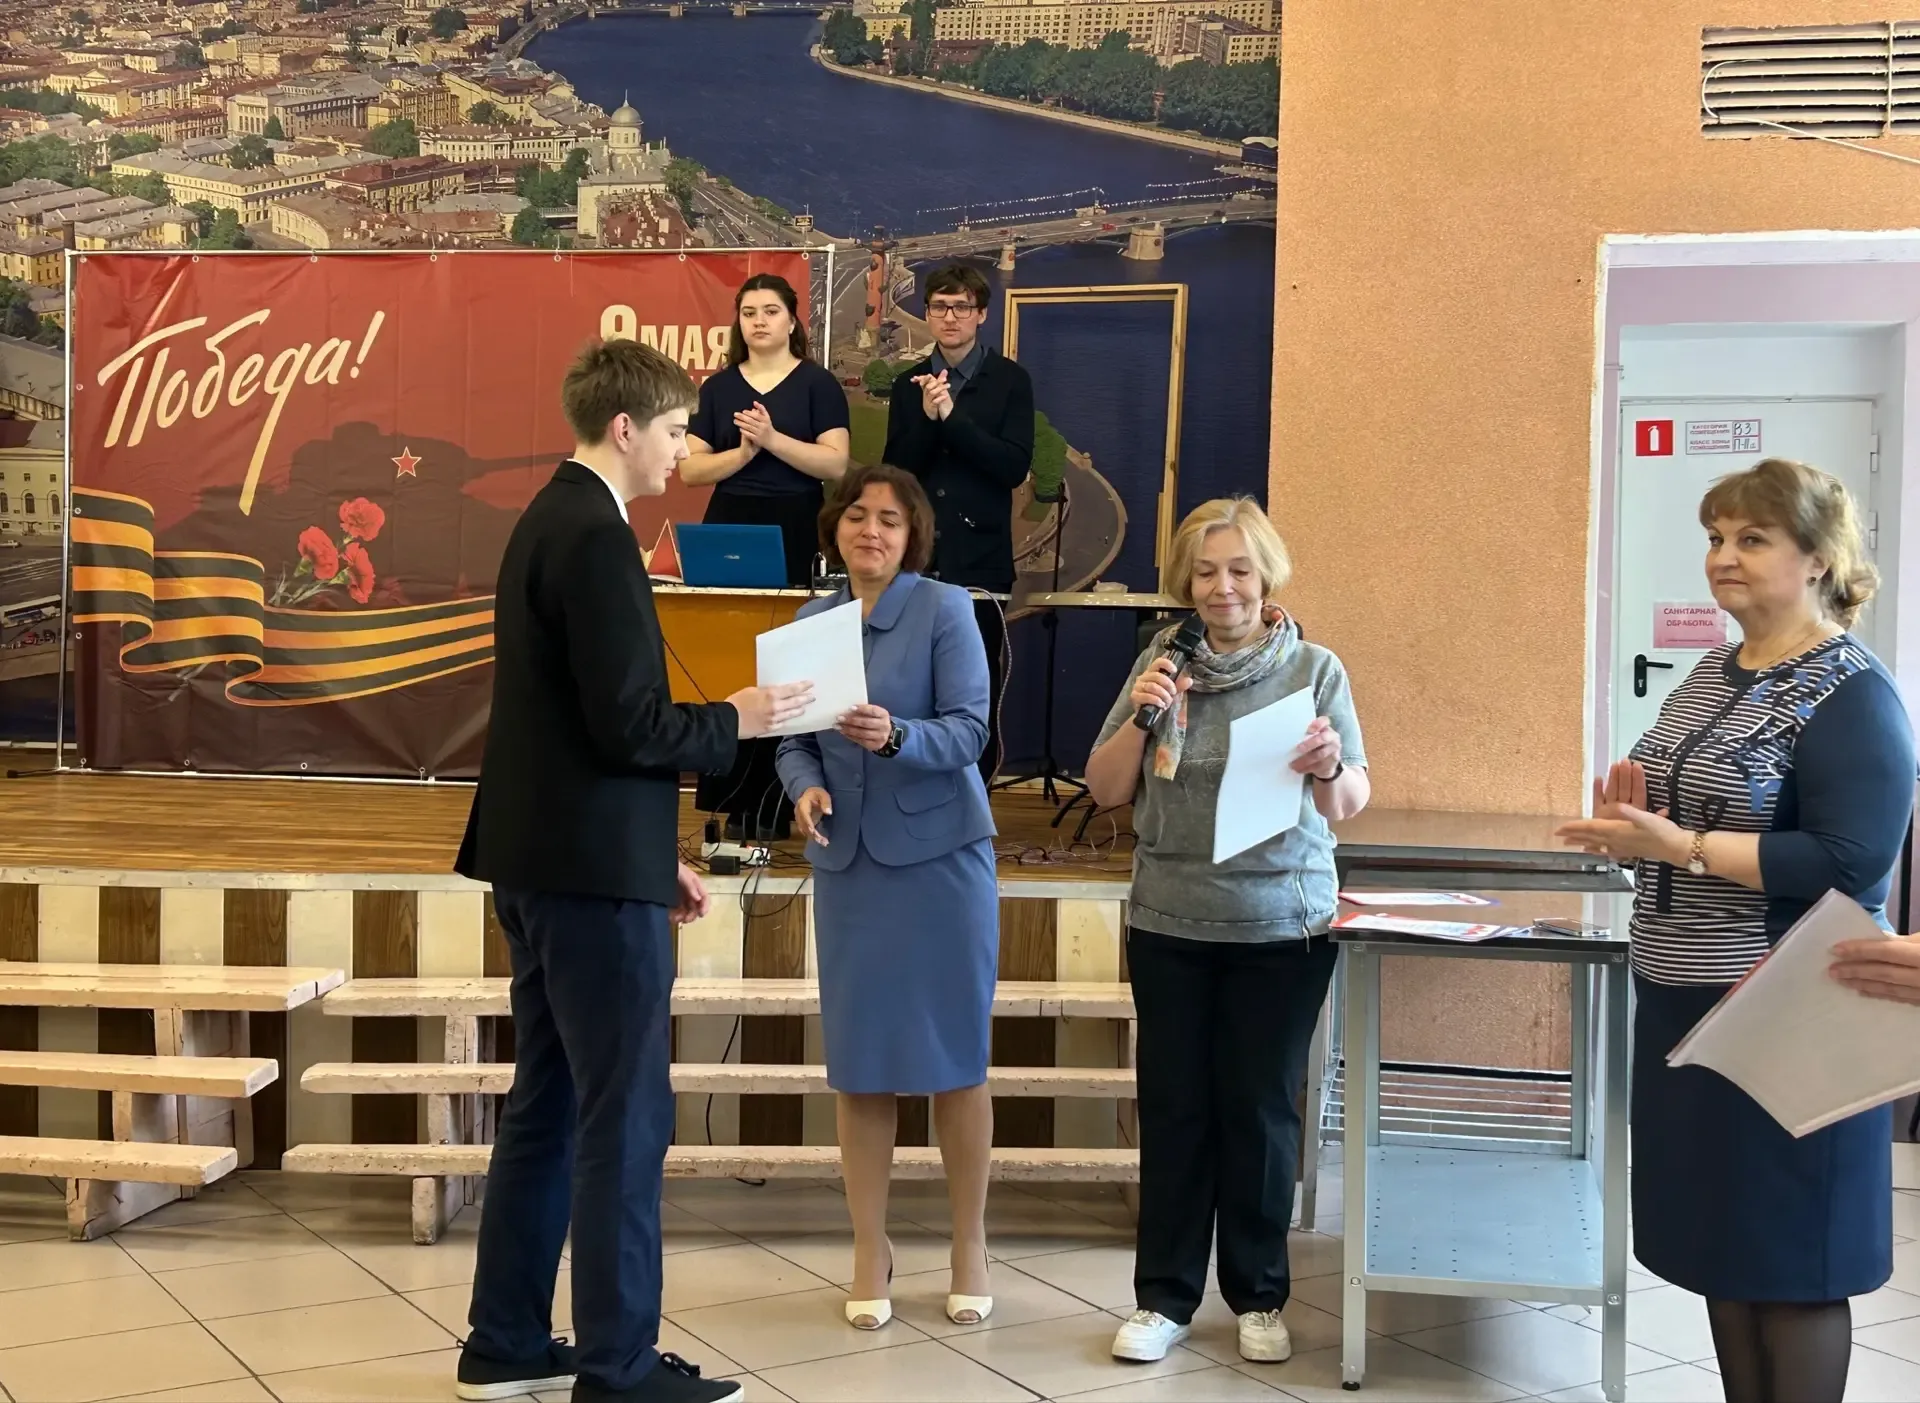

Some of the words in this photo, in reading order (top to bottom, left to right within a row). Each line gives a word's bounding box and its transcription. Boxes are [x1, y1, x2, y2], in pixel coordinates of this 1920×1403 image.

[641, 325, 731, 370] МАЯ
[97, 308, 385, 516] Победа!
[1663, 607, 1717, 615] САНИТАРНАЯ
[1666, 619, 1714, 627] ОБРАБОТКА
